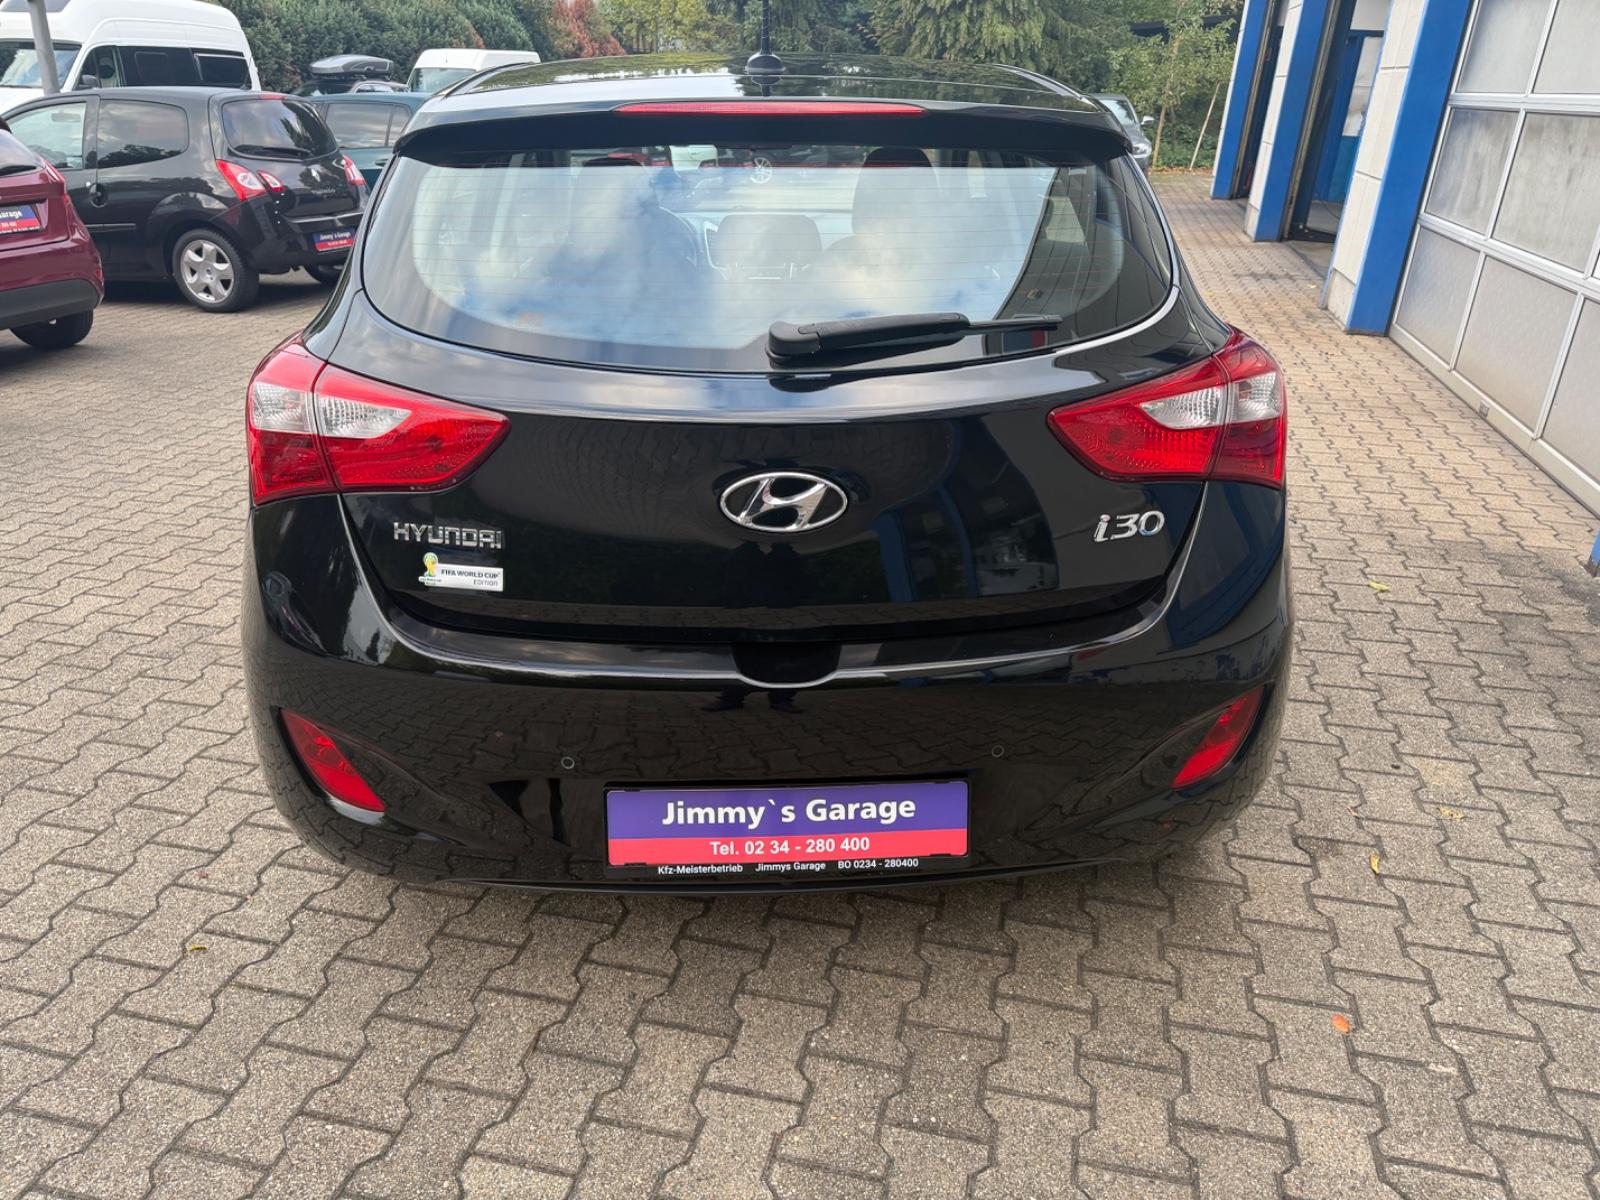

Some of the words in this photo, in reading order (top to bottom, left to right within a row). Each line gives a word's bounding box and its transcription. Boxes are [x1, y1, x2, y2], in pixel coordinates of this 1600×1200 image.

[393, 521, 502, 549] HYUNDAI
[1093, 510, 1165, 542] i30
[440, 569, 456, 577] FIFA
[457, 570, 483, 578] WORLD
[484, 571, 498, 579] CUP
[806, 799, 916, 824] Garage
[709, 841, 739, 856] Tel.
[744, 841, 764, 855] 02
[770, 839, 790, 854] 34
[805, 838, 836, 853] 280
[840, 837, 870, 852] 400
[657, 864, 743, 875] Kfz-Meisterbetrieb
[755, 862, 791, 873] Jimmys
[793, 861, 826, 872] Garage
[838, 860, 851, 869] BO
[853, 859, 876, 869] 0234
[884, 858, 919, 868] 280400
